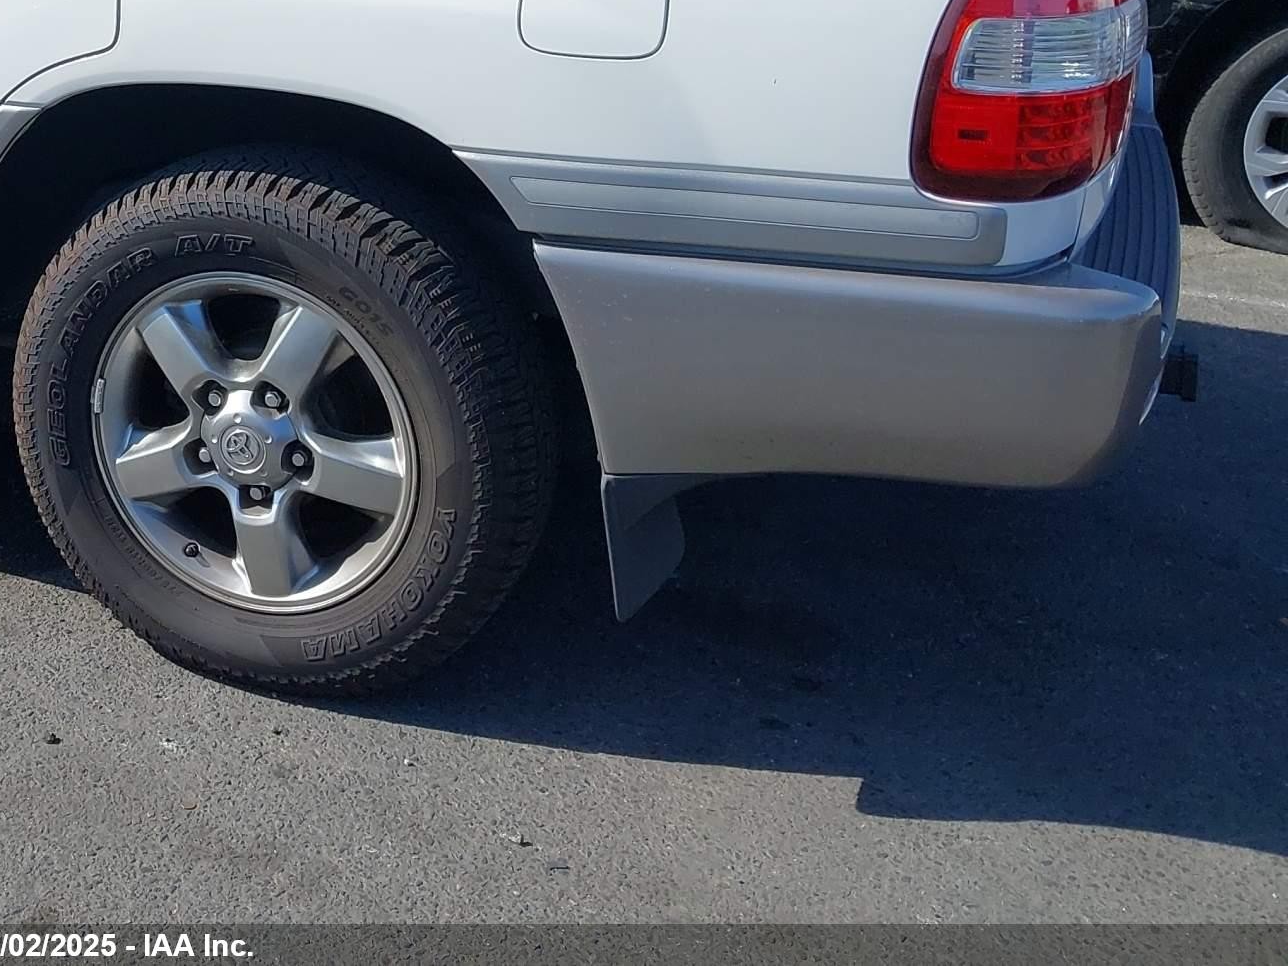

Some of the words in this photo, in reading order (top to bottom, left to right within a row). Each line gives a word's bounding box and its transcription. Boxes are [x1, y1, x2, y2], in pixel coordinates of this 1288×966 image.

[47, 246, 154, 467] GEOLANDAR
[174, 233, 254, 257] A/T
[300, 506, 457, 662] YOKOHAMA
